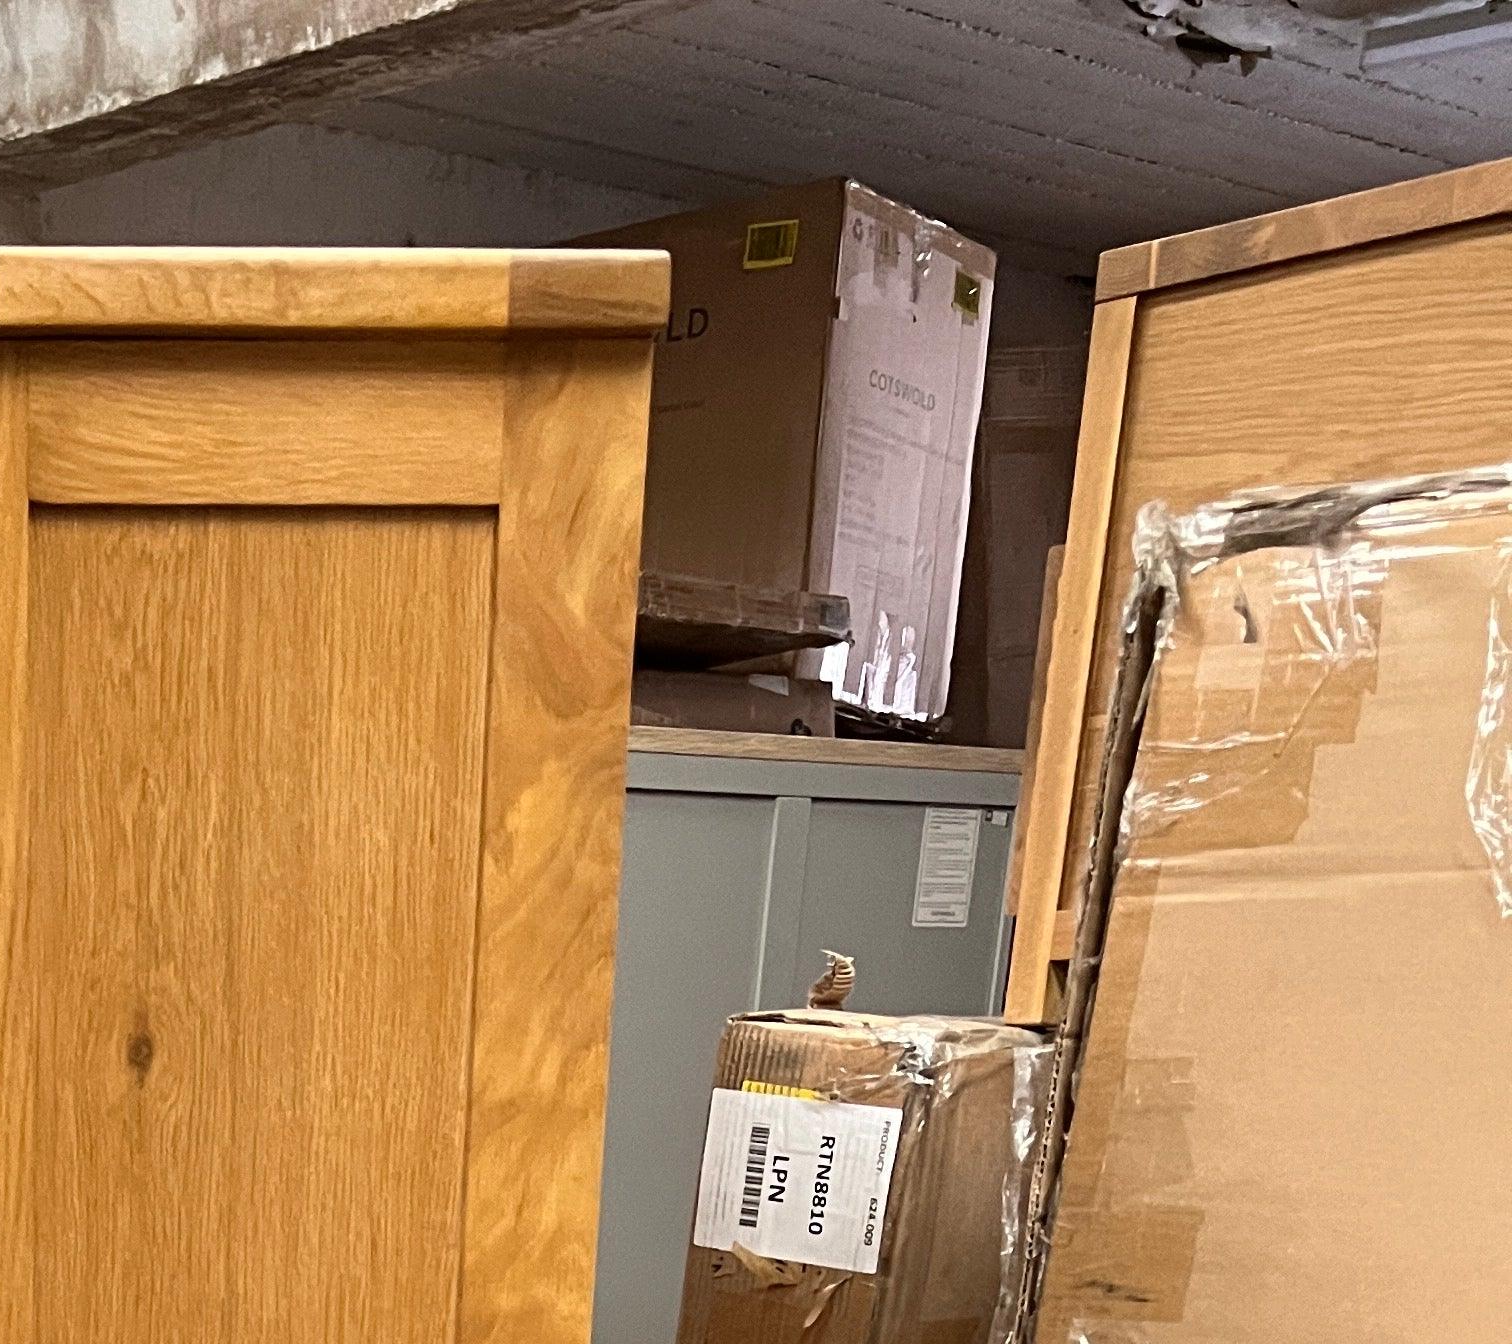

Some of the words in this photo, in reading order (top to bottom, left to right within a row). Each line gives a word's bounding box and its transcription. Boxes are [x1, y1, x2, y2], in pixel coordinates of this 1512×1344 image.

[869, 369, 936, 411] COTSWOLD
[875, 1121, 891, 1173] PRODUCT
[767, 1155, 790, 1204] LPN
[808, 1135, 836, 1236] RTN8810
